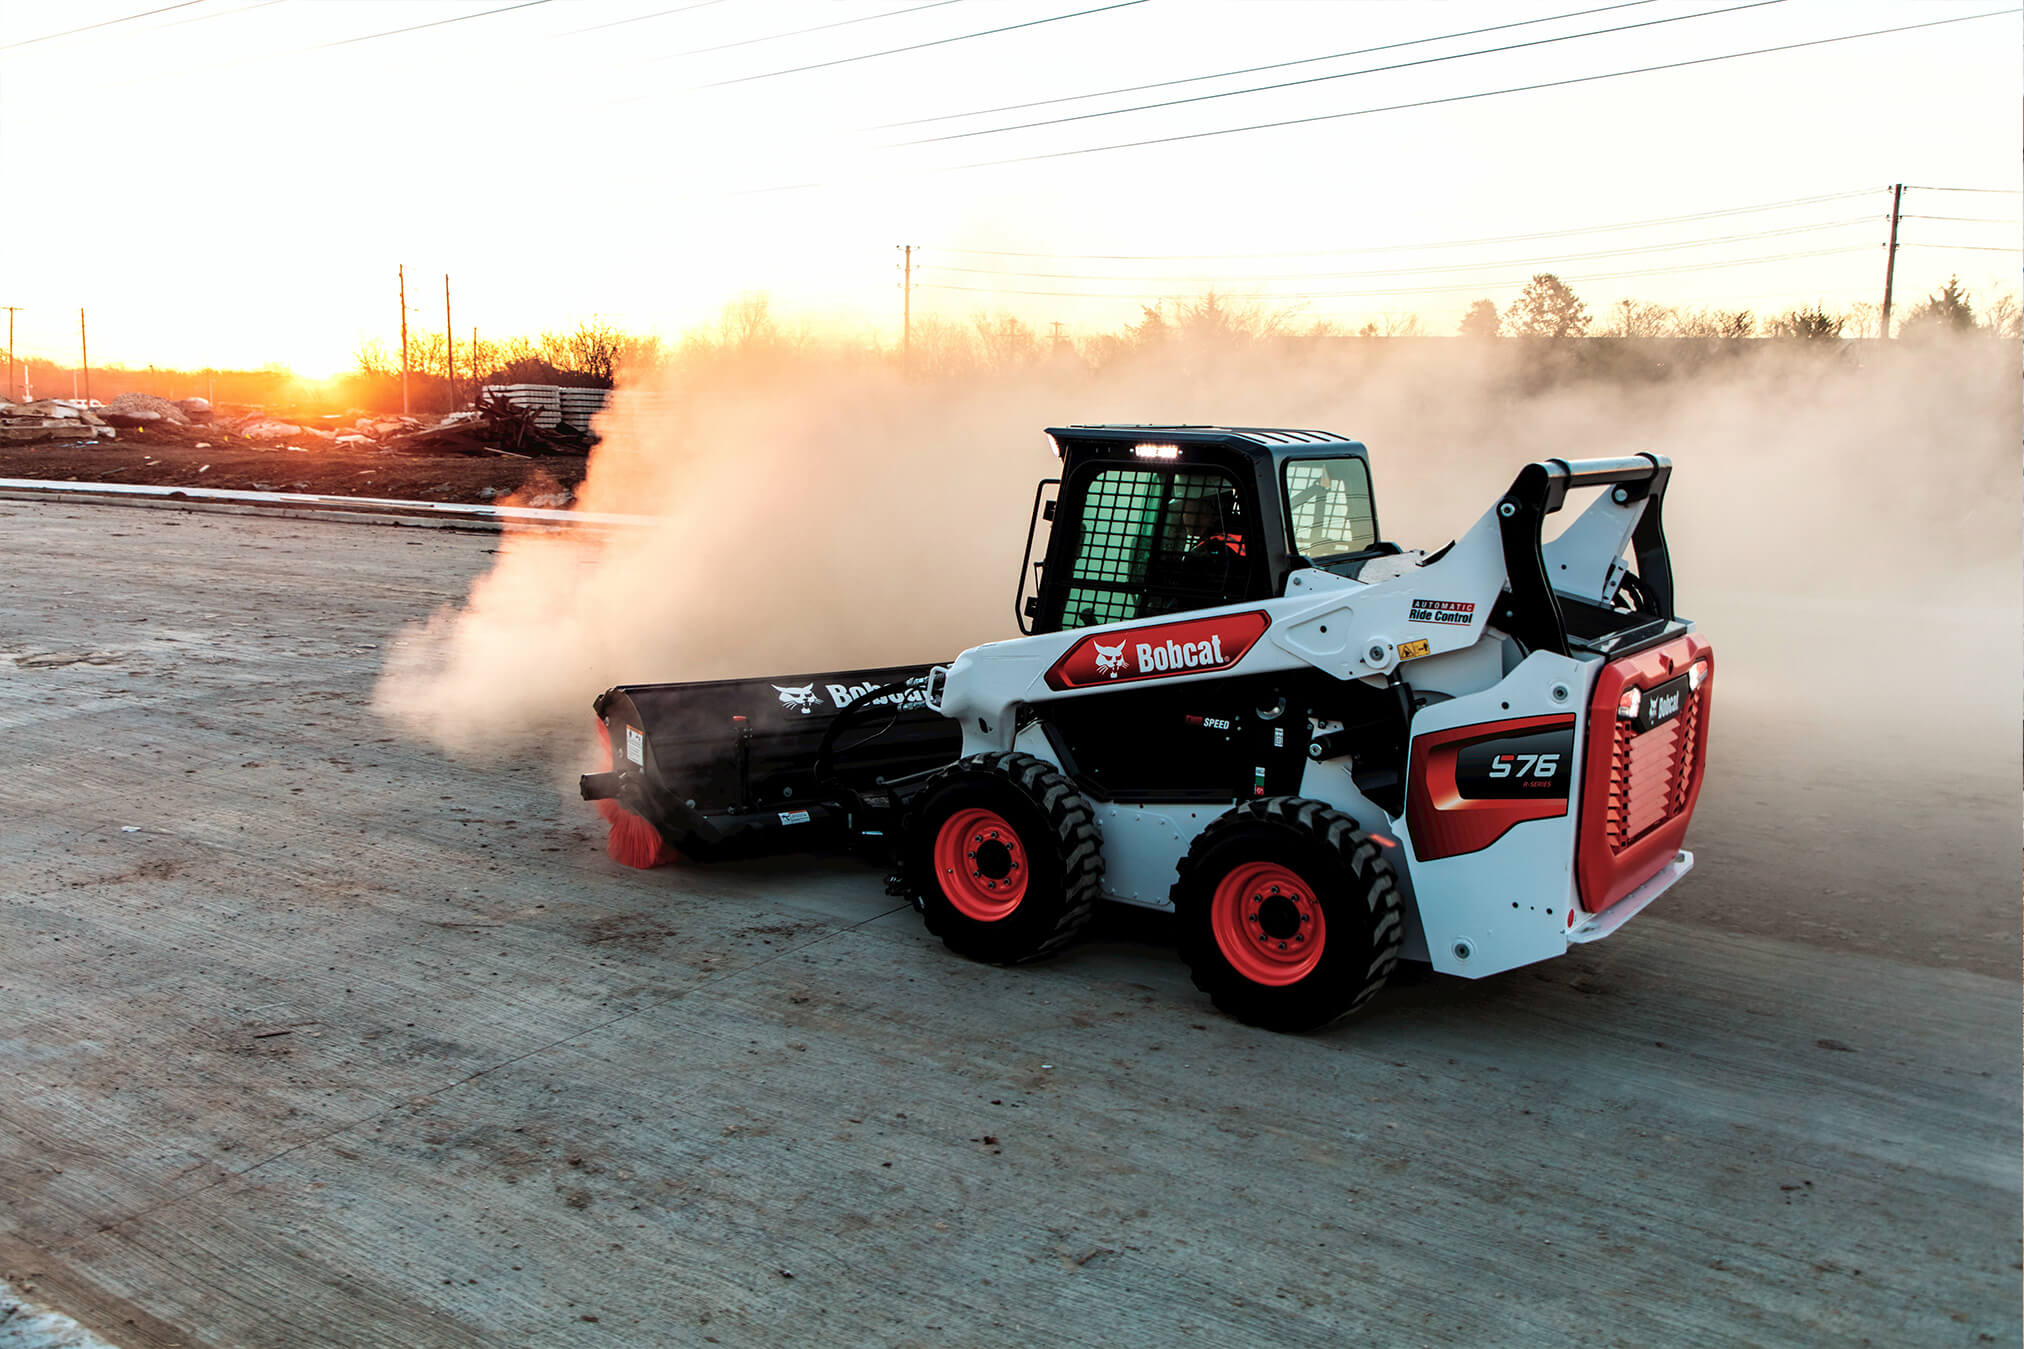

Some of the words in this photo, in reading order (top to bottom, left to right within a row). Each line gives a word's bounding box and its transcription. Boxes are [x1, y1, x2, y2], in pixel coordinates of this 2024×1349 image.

[1414, 600, 1473, 611] AUTOMATIC
[1409, 609, 1432, 620] Ride
[1434, 611, 1473, 623] Control
[1135, 634, 1224, 673] Bobcat
[1657, 690, 1679, 720] Bobcat
[1203, 717, 1230, 730] SPEED
[1489, 754, 1560, 778] S76
